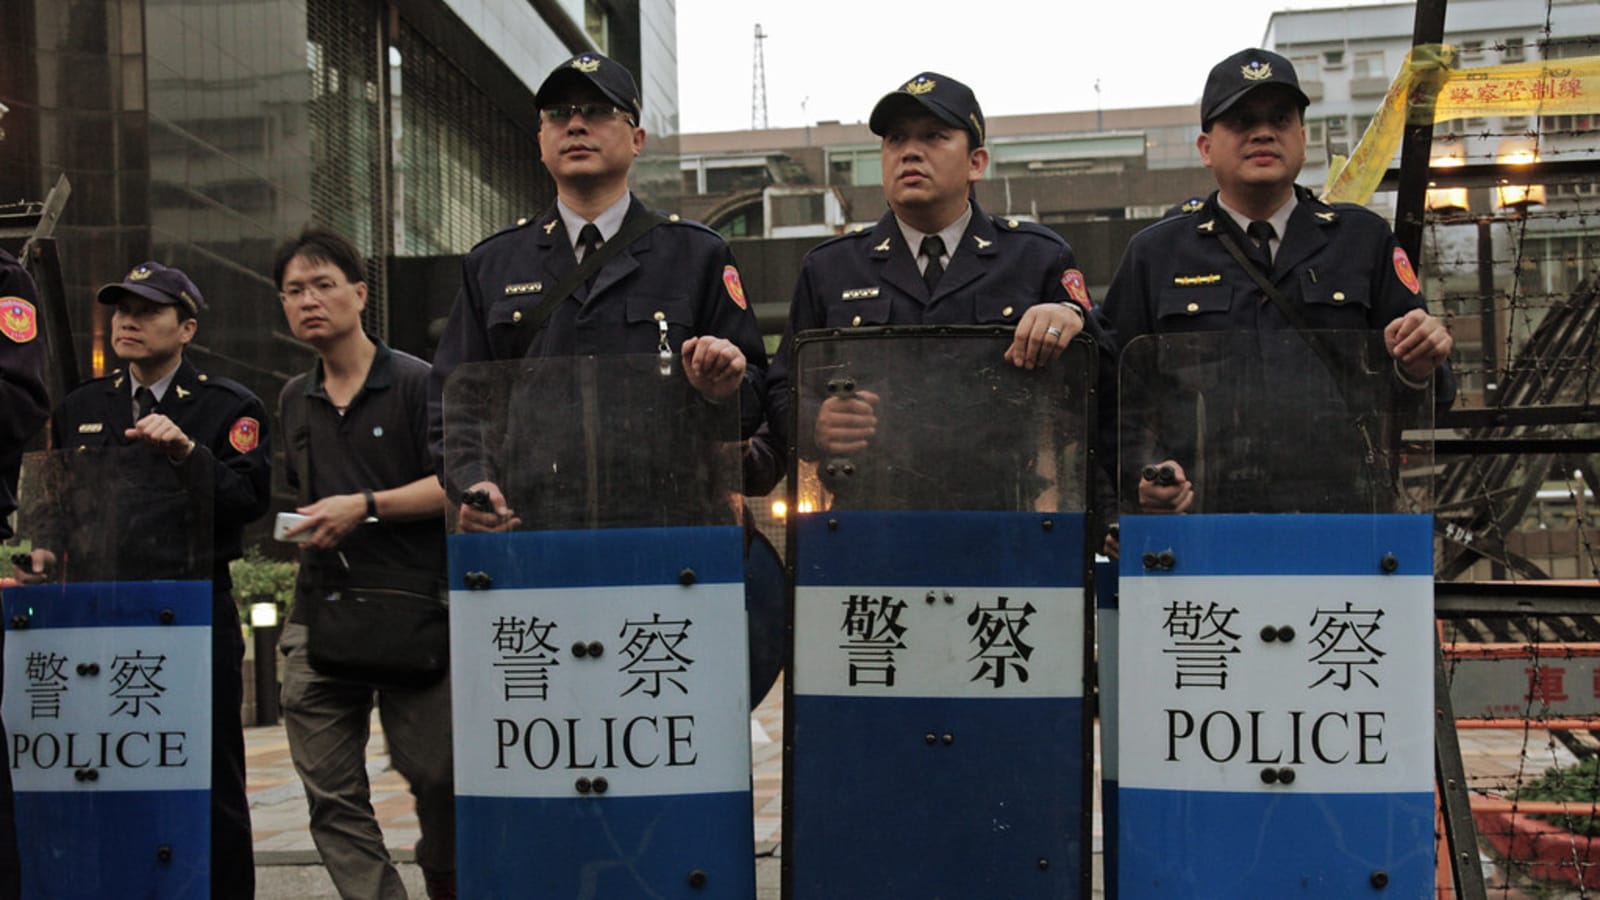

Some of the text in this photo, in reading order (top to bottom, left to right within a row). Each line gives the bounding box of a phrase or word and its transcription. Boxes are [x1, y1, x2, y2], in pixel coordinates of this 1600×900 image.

[492, 612, 695, 701] 警察
[839, 595, 1037, 688] 警察
[1162, 601, 1387, 691] 警察
[25, 650, 167, 719] 警察
[1524, 665, 1600, 706] 車
[12, 732, 188, 769] POLICE
[494, 715, 698, 770] POLICE
[1163, 709, 1388, 765] POLICE
